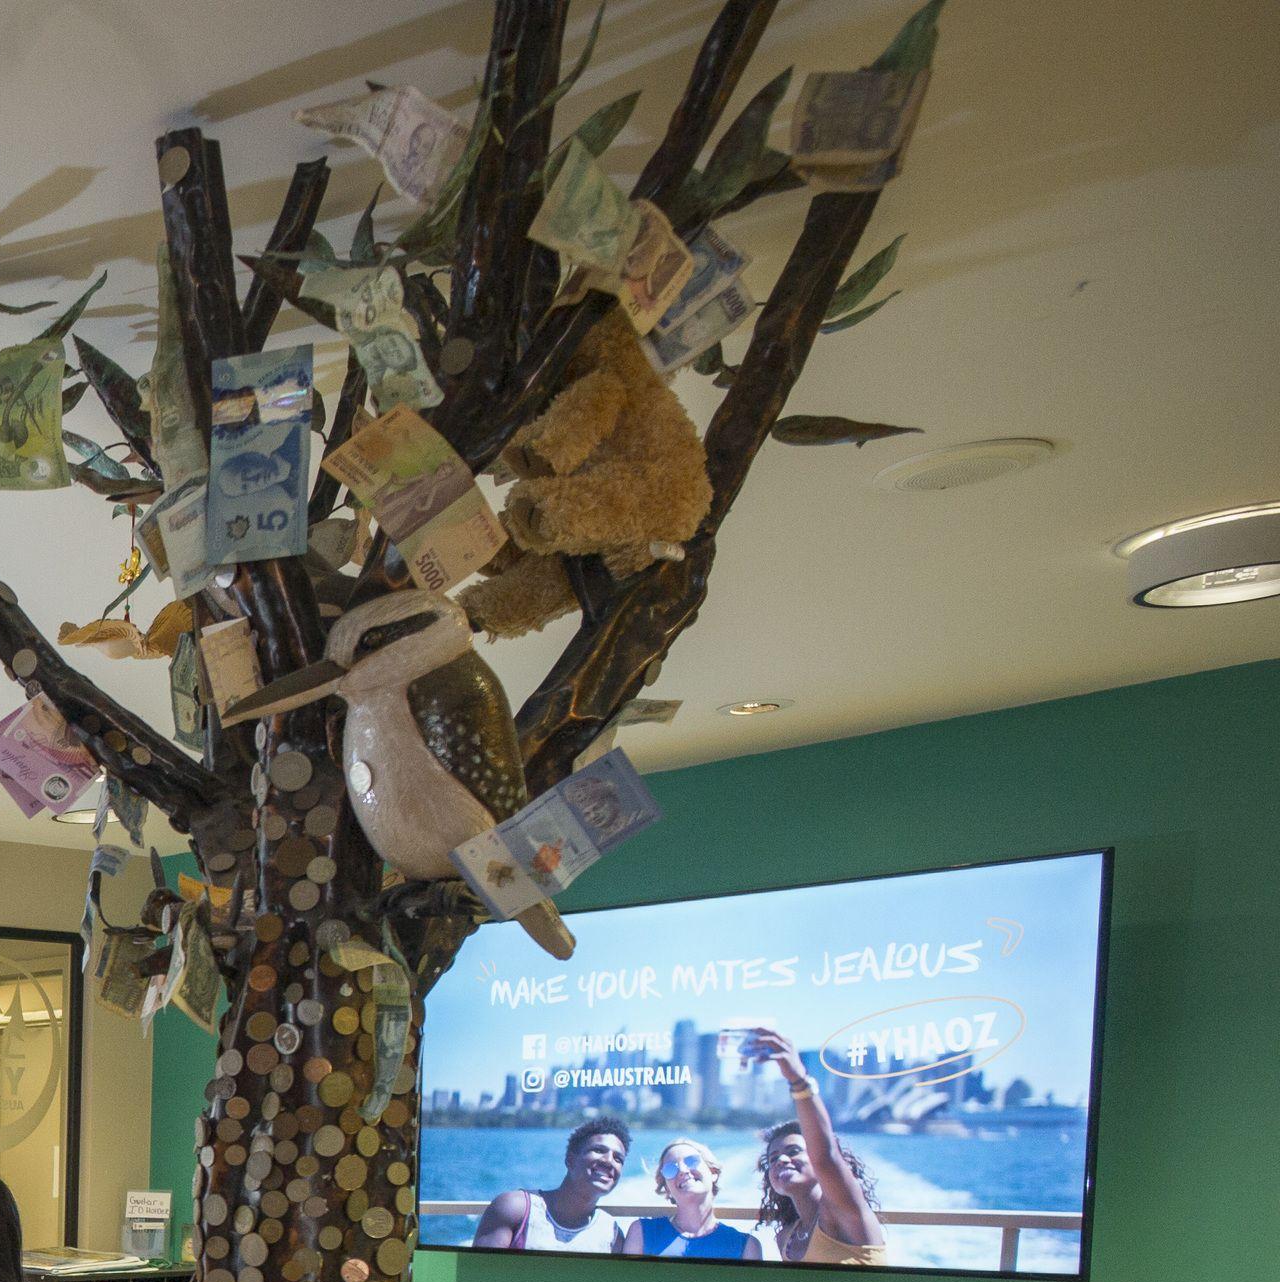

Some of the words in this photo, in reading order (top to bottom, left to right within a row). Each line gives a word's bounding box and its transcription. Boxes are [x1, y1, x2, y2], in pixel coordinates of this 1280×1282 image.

[256, 508, 289, 532] 5
[414, 551, 446, 592] 5000
[490, 974, 569, 1010] MAKE
[577, 965, 663, 1009] YOUR
[671, 956, 799, 997] MATES
[811, 939, 983, 987] JEALOUS
[553, 1031, 673, 1056] @YHAHOSTELS
[846, 1011, 1000, 1067] #YHAOZ
[553, 1065, 693, 1089] @YHAAUSTRALIA
